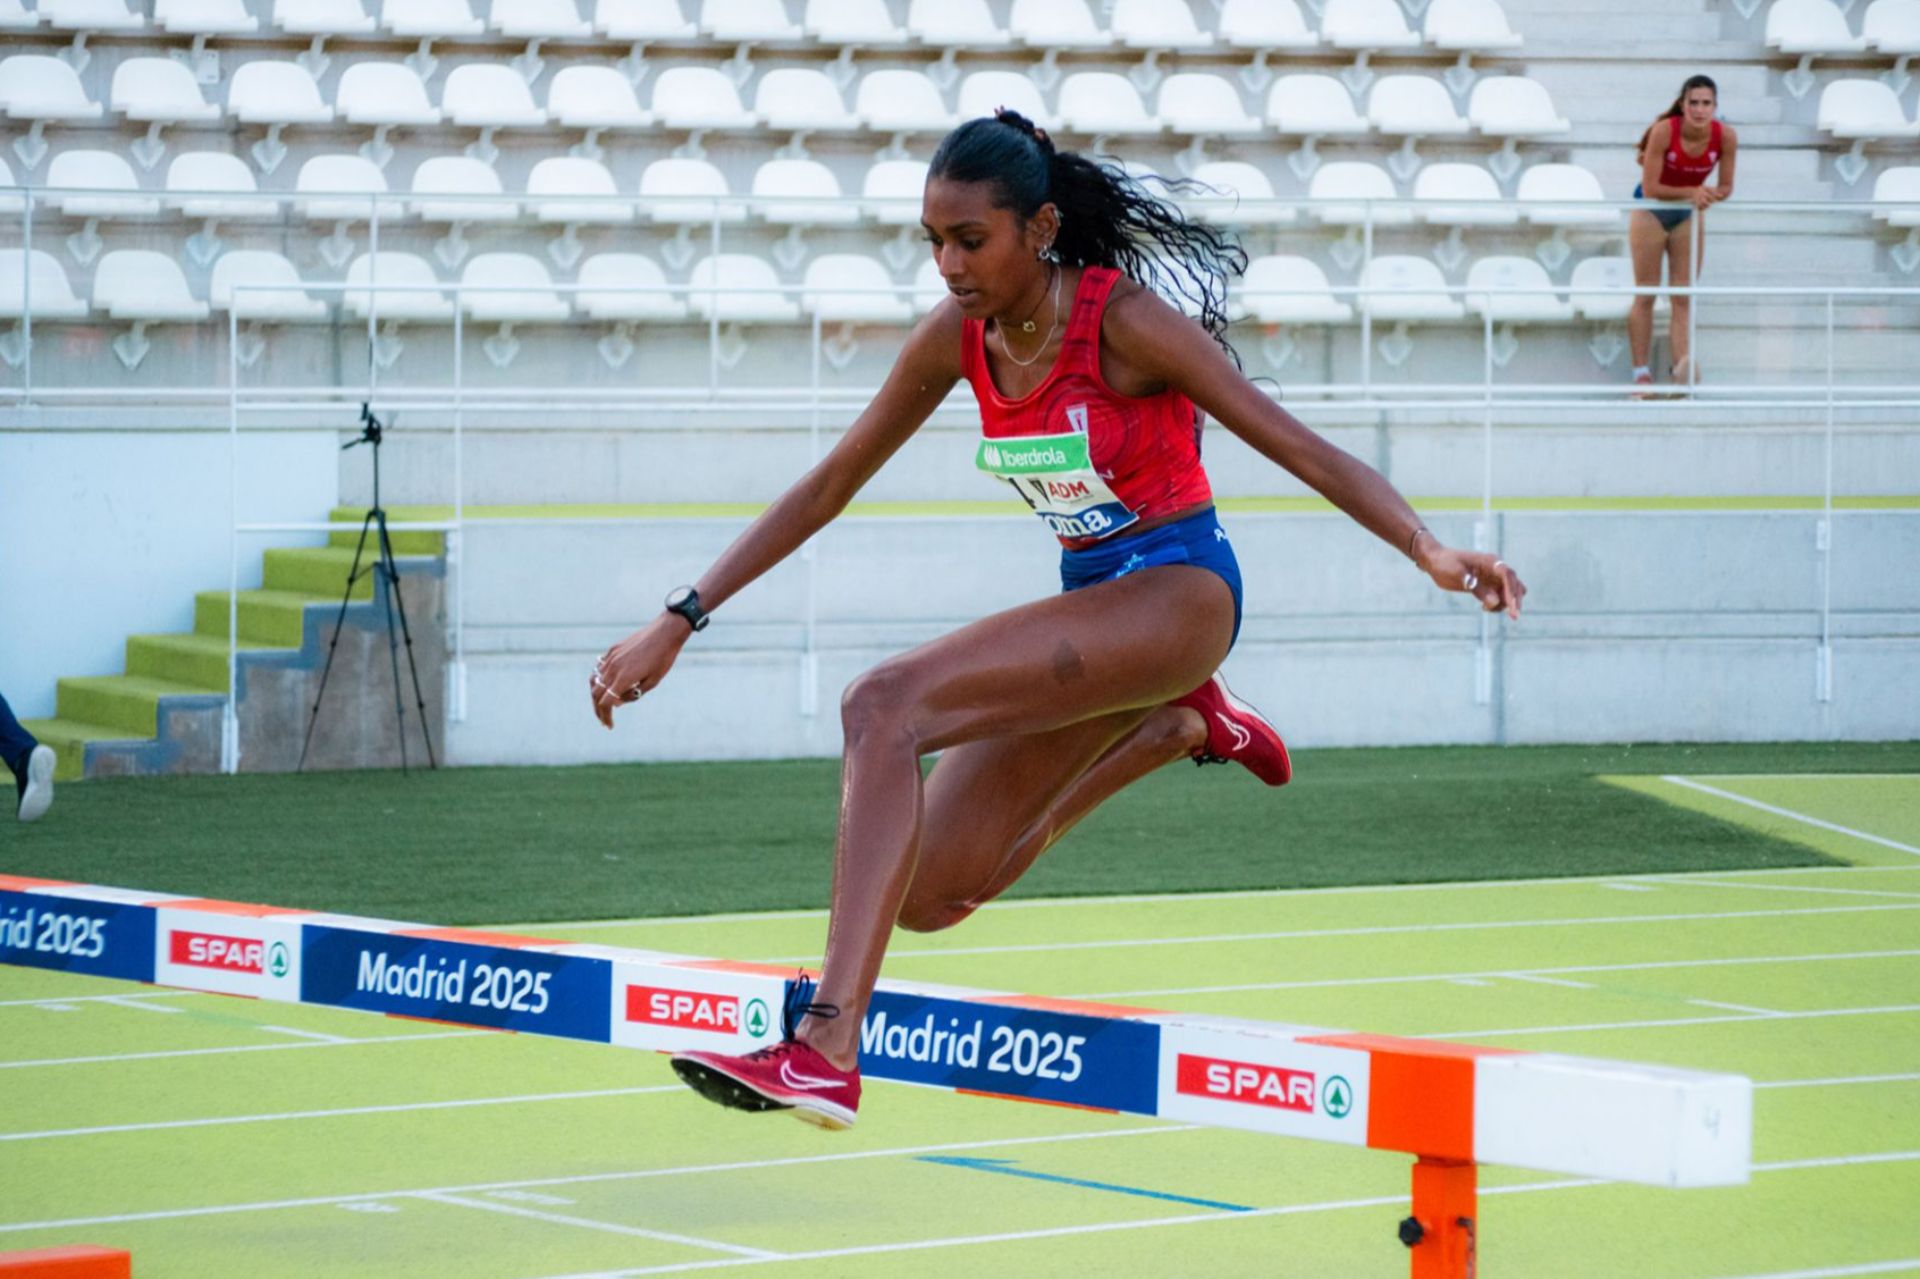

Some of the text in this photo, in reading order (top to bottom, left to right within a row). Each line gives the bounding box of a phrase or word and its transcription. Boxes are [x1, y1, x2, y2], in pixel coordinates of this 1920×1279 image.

[1001, 446, 1067, 467] Iberdrola
[1048, 480, 1091, 499] ADM
[35, 912, 108, 958] 2025
[188, 937, 263, 968] SPAR
[357, 950, 552, 1014] Madrid 2025
[650, 993, 739, 1027] SPAR
[860, 1011, 1087, 1082] Madrid 2025
[1206, 1064, 1314, 1107] SPAR
